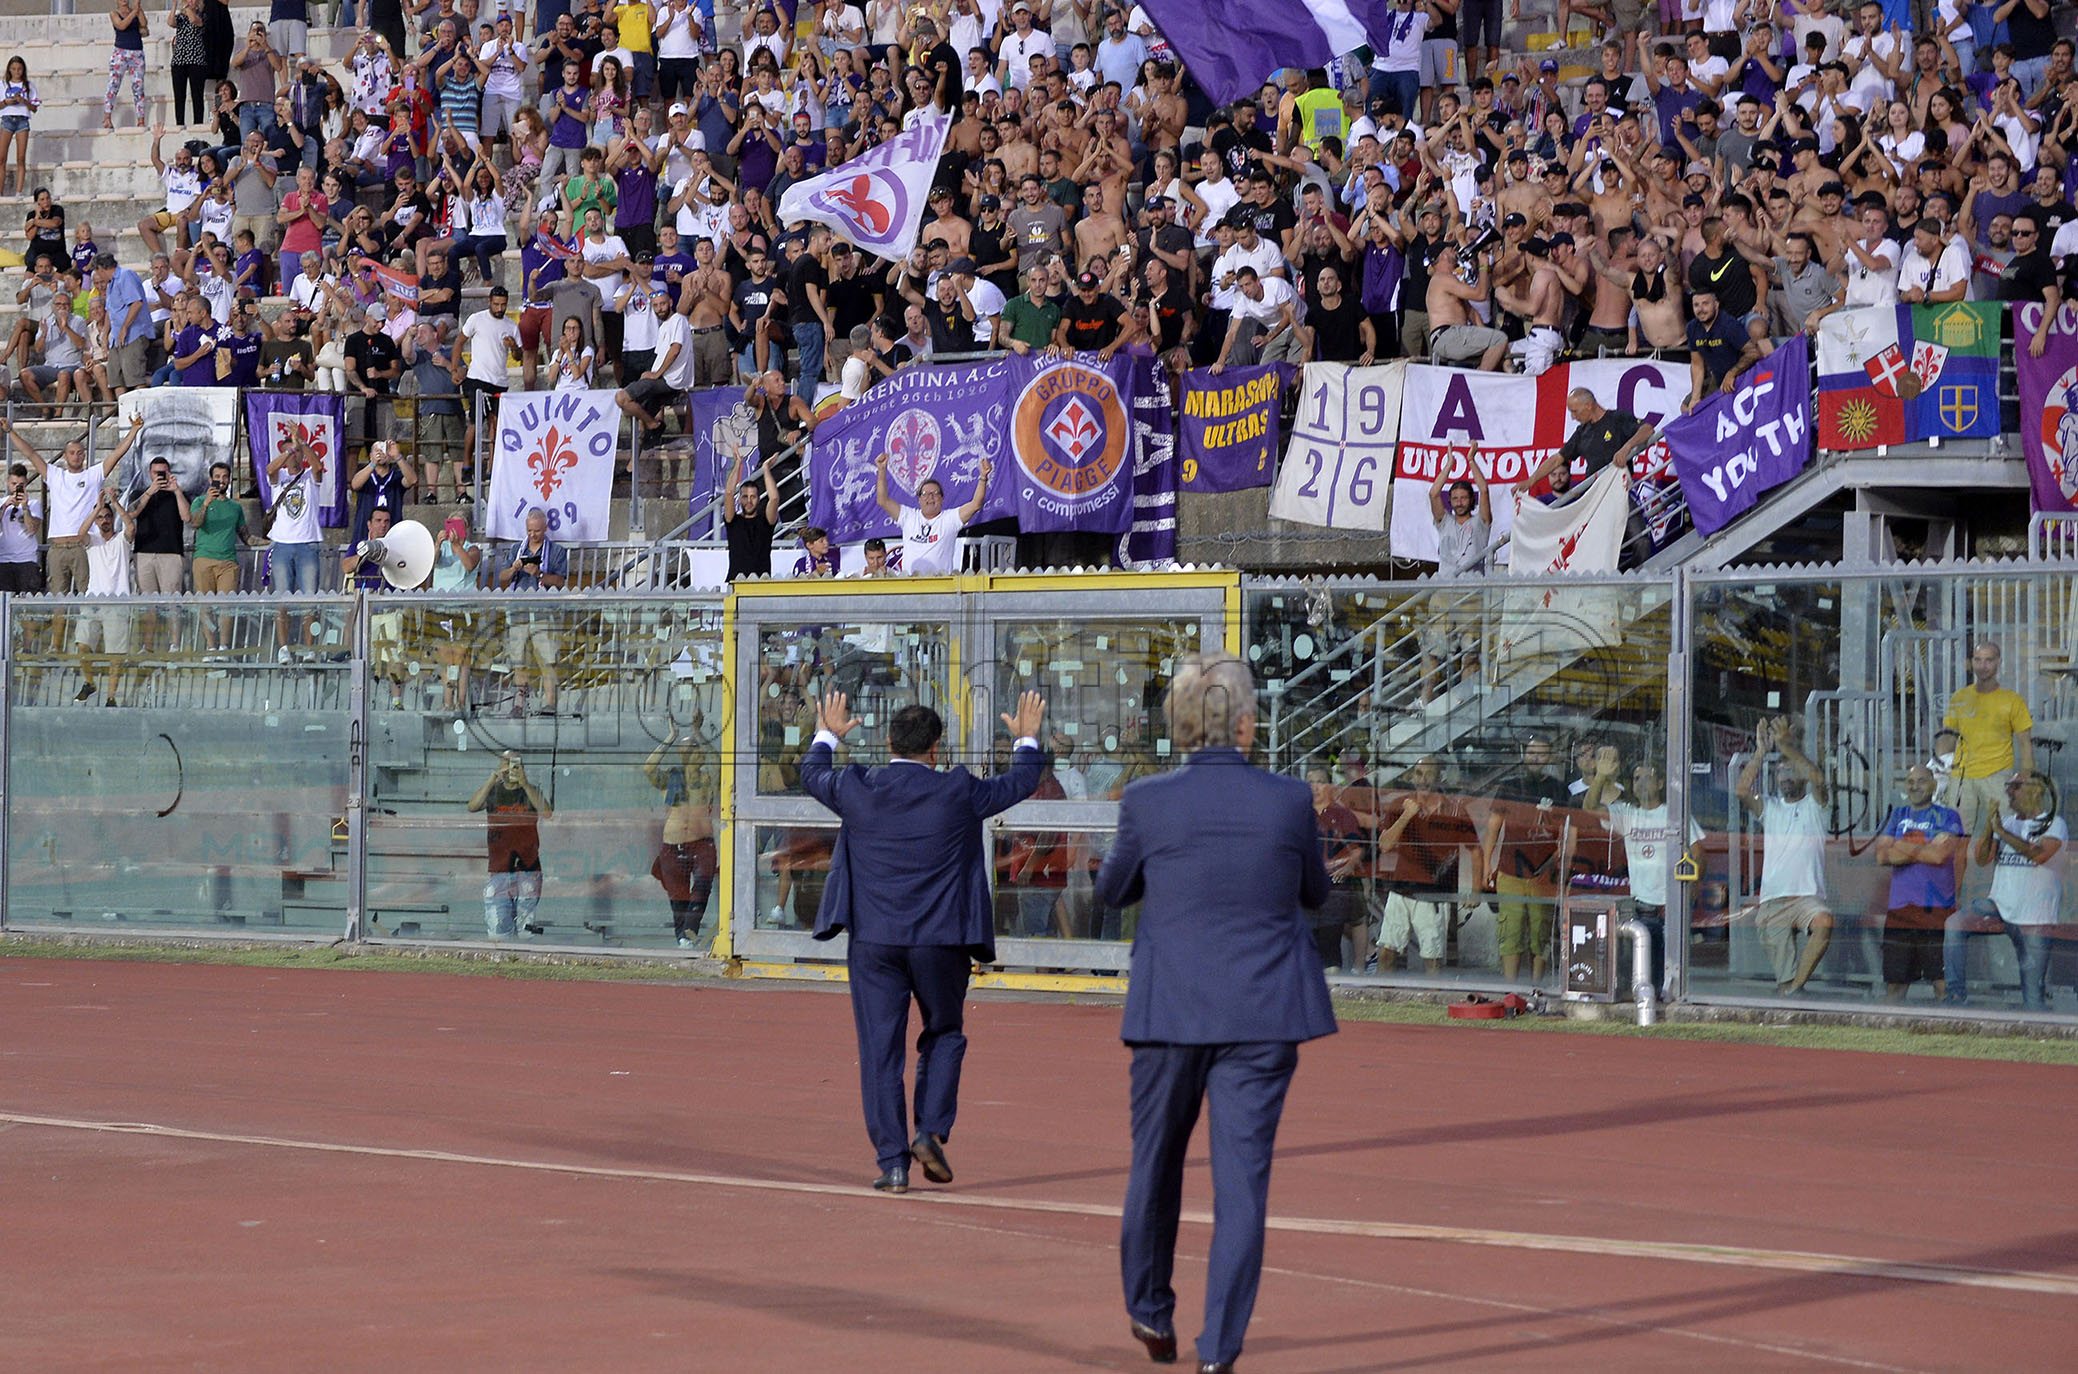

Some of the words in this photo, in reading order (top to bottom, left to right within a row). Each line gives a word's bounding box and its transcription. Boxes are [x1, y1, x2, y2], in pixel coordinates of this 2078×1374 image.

[840, 371, 959, 411] RENTINA
[1036, 370, 1112, 401] GRUPPO
[1431, 374, 1485, 441] A
[1616, 364, 1666, 427] C
[502, 393, 612, 457] QUINTO
[1203, 408, 1269, 449] ULTRAS
[1035, 458, 1112, 492] PIAGGE
[514, 498, 578, 532] 189
